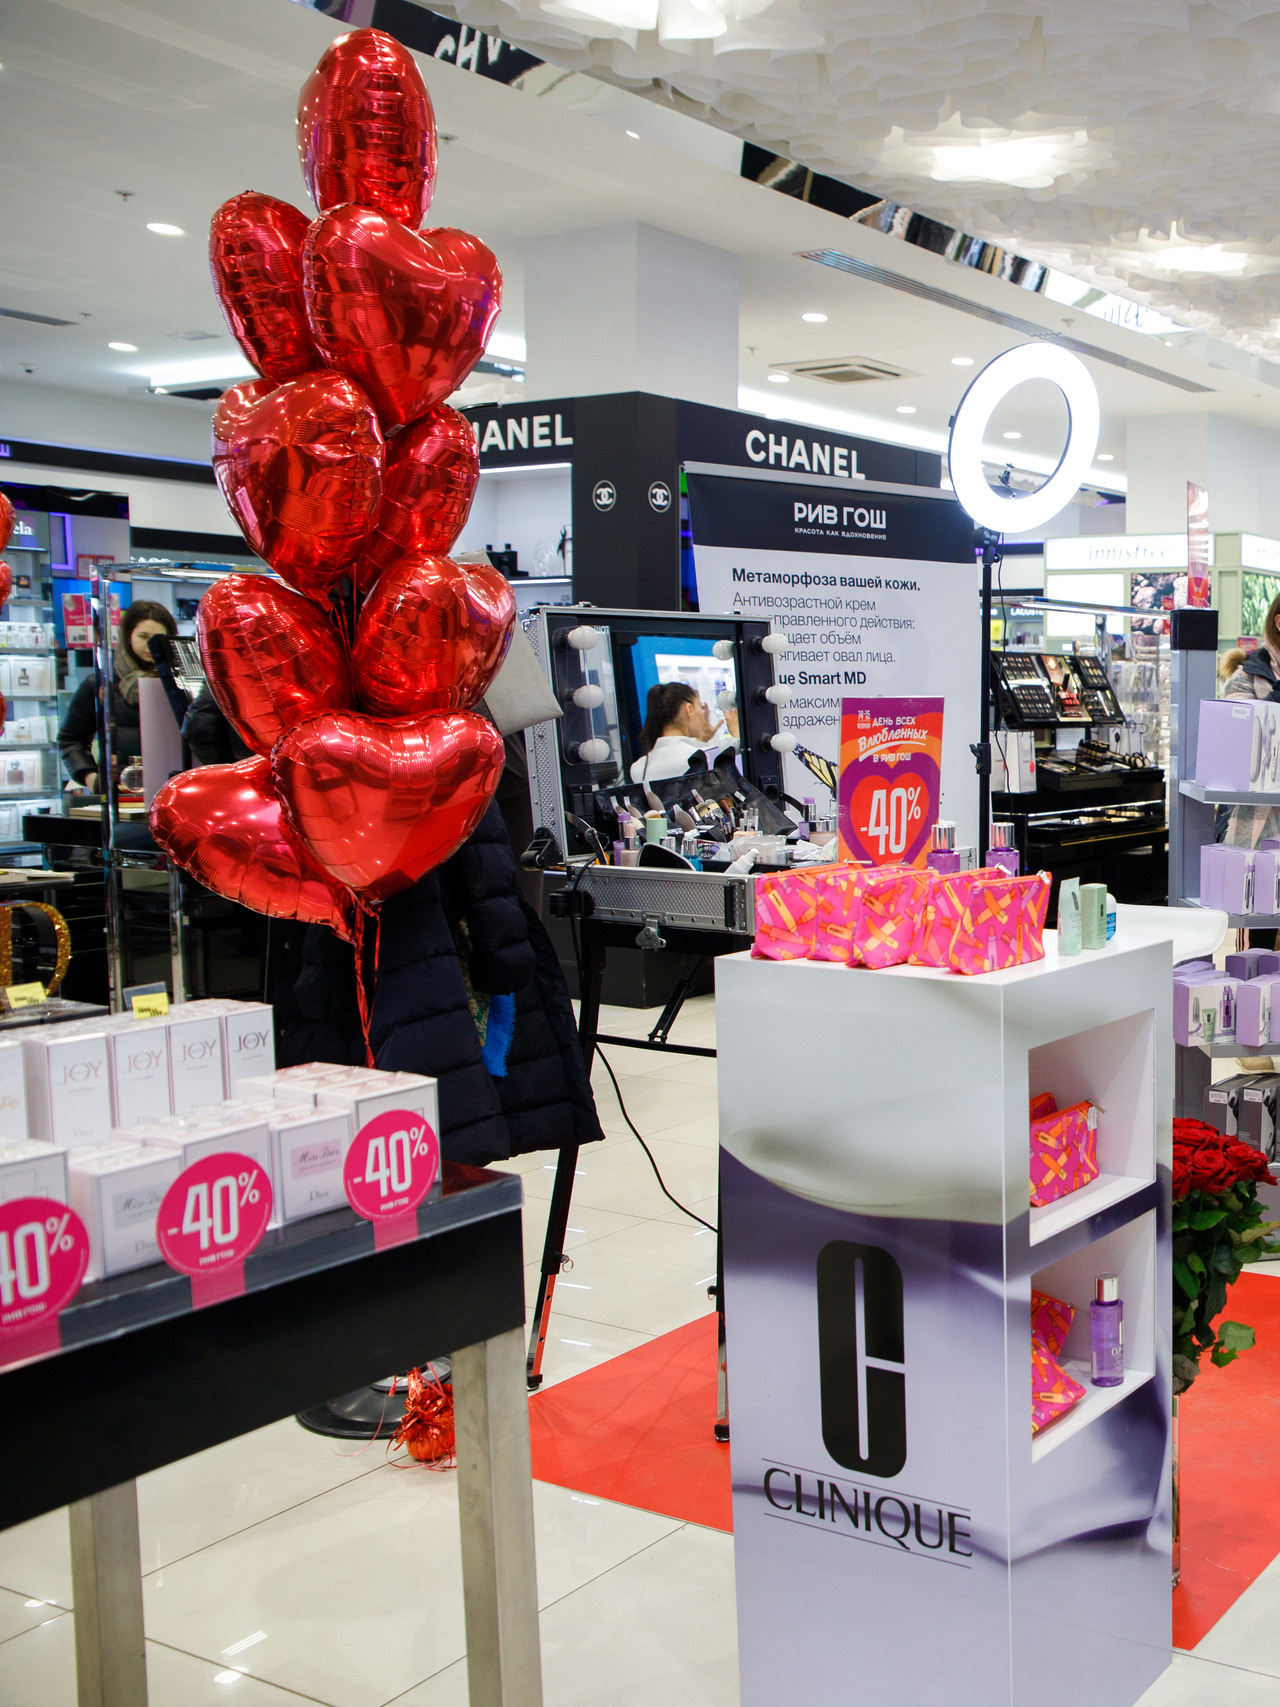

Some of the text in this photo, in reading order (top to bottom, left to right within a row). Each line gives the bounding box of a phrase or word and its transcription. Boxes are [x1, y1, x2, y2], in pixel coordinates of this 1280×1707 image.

[745, 430, 866, 481] CHANEL
[794, 502, 886, 529] РИВ ГОШ
[794, 527, 887, 540] КРАСОТА КАК ВДОХНОВЕНИЕ
[732, 568, 921, 591] Метаморфоза вашей кожи.
[733, 592, 876, 613] Антивозрастной крем
[774, 613, 916, 630] правленного действия:
[819, 630, 862, 645] объём
[779, 650, 896, 665] ягивает овал лица.
[798, 671, 841, 685] Smart
[843, 671, 867, 685] MD
[789, 697, 840, 709] максим
[872, 716, 917, 727] ДЕНЬ ВСЕХ
[857, 727, 928, 752] Влюбленных
[873, 752, 912, 763] В РИВ ГОШ
[860, 786, 921, 856] -40%
[178, 1039, 217, 1063] JOY
[233, 1030, 270, 1053] JOY
[57, 1060, 103, 1085] JOY
[122, 1049, 163, 1074] JOY
[353, 1124, 429, 1198] -40%
[309, 1189, 329, 1200] Dior
[167, 1169, 260, 1250] -40%
[763, 1467, 973, 1558] CLINIQUE
